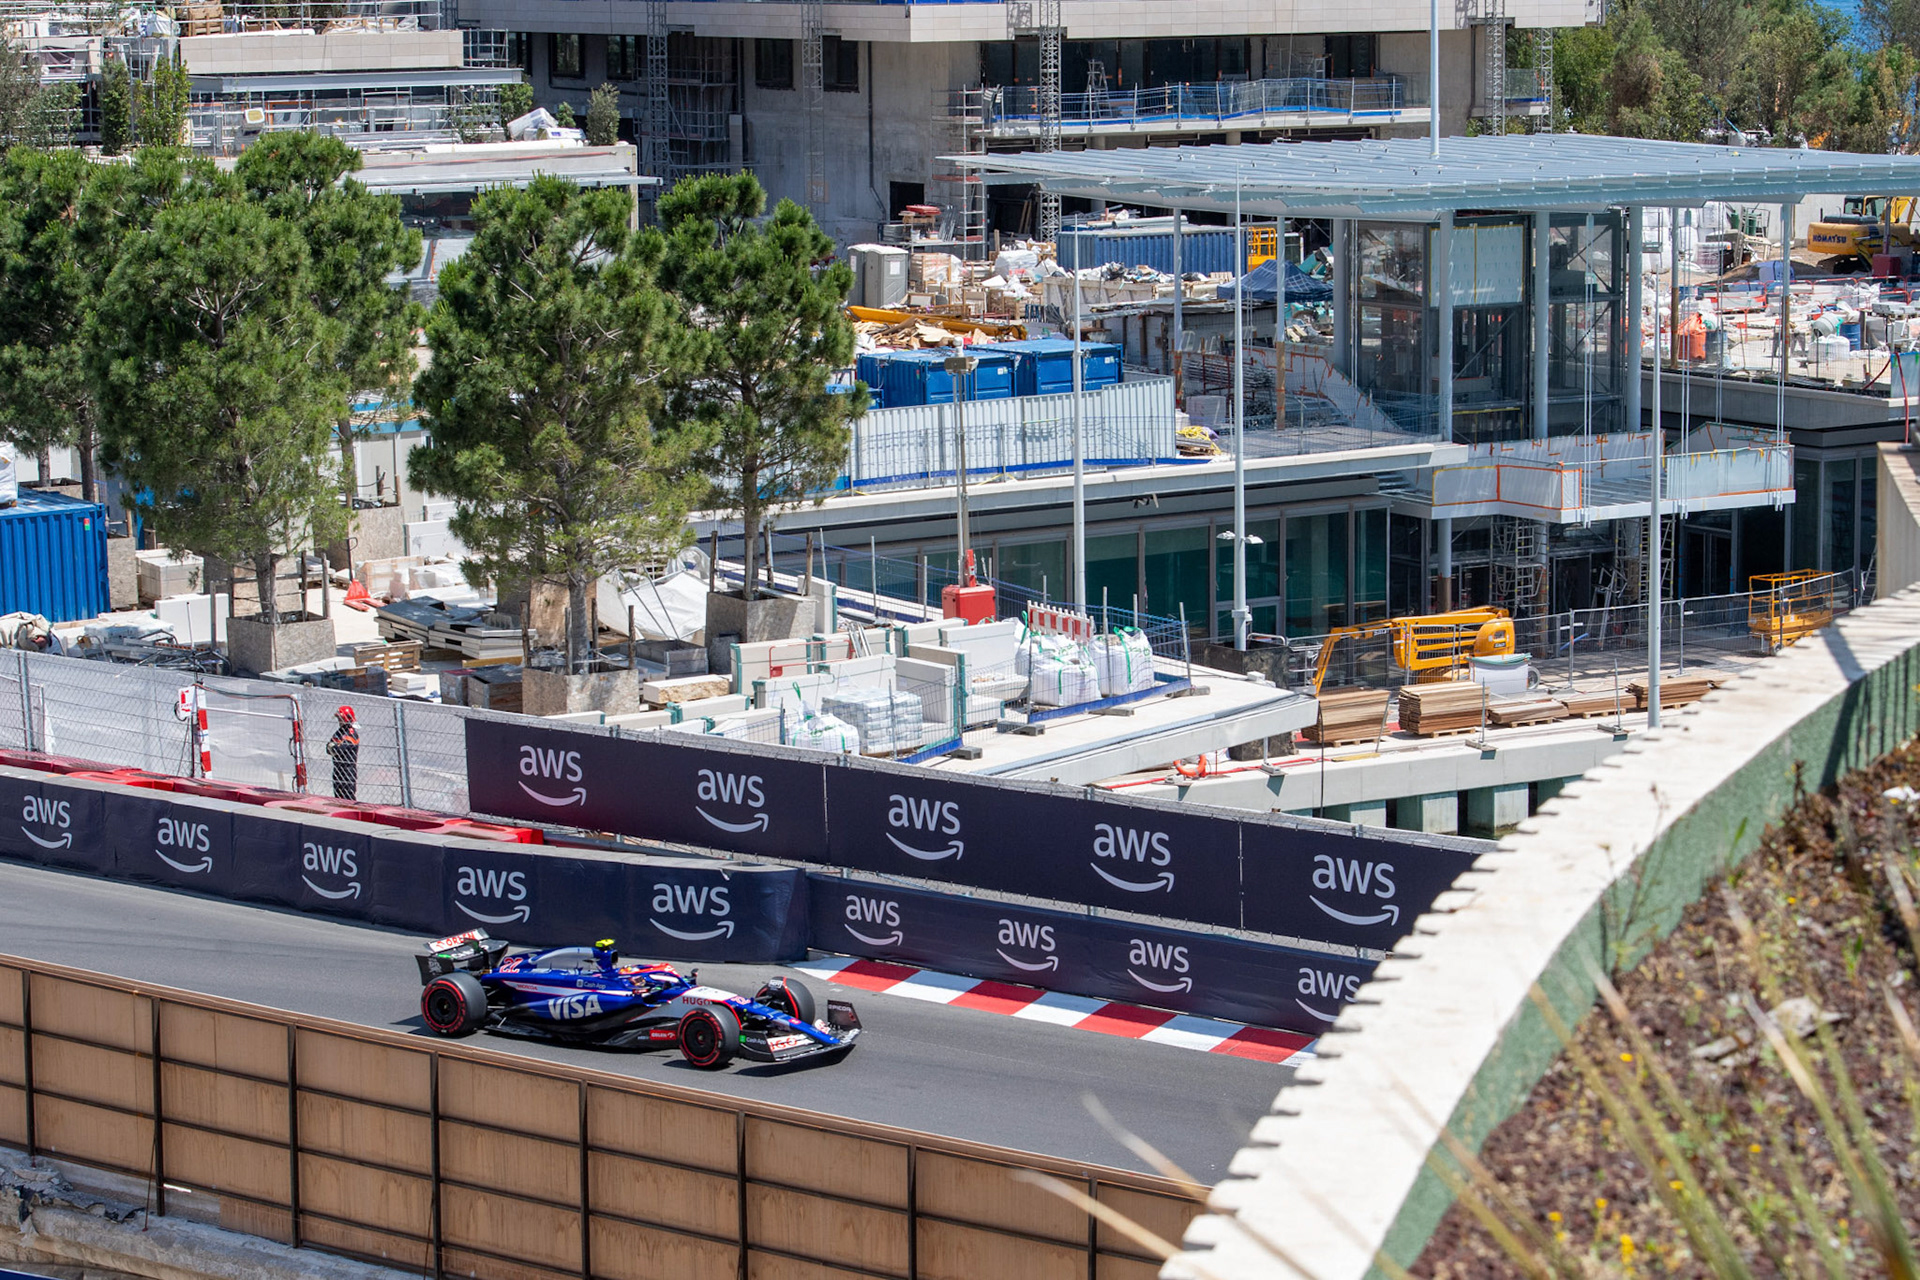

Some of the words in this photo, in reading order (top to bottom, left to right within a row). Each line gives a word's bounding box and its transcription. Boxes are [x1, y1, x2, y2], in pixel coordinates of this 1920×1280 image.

[1812, 234, 1847, 244] KOMATSU
[519, 745, 583, 783] aws
[697, 769, 765, 808] aws
[23, 795, 70, 828] aws
[888, 794, 960, 835] aws
[157, 818, 210, 852] aws
[1093, 823, 1171, 866] aws
[303, 842, 357, 878] aws
[1312, 854, 1396, 899] aws
[457, 866, 526, 901] aws
[652, 883, 730, 916] aws
[845, 895, 900, 927] aws
[998, 919, 1056, 952] aws
[499, 957, 524, 974] 22
[1129, 938, 1190, 973] aws
[682, 996, 711, 1006] HUGO
[1297, 967, 1361, 1003] aws
[548, 994, 603, 1021] VISA
